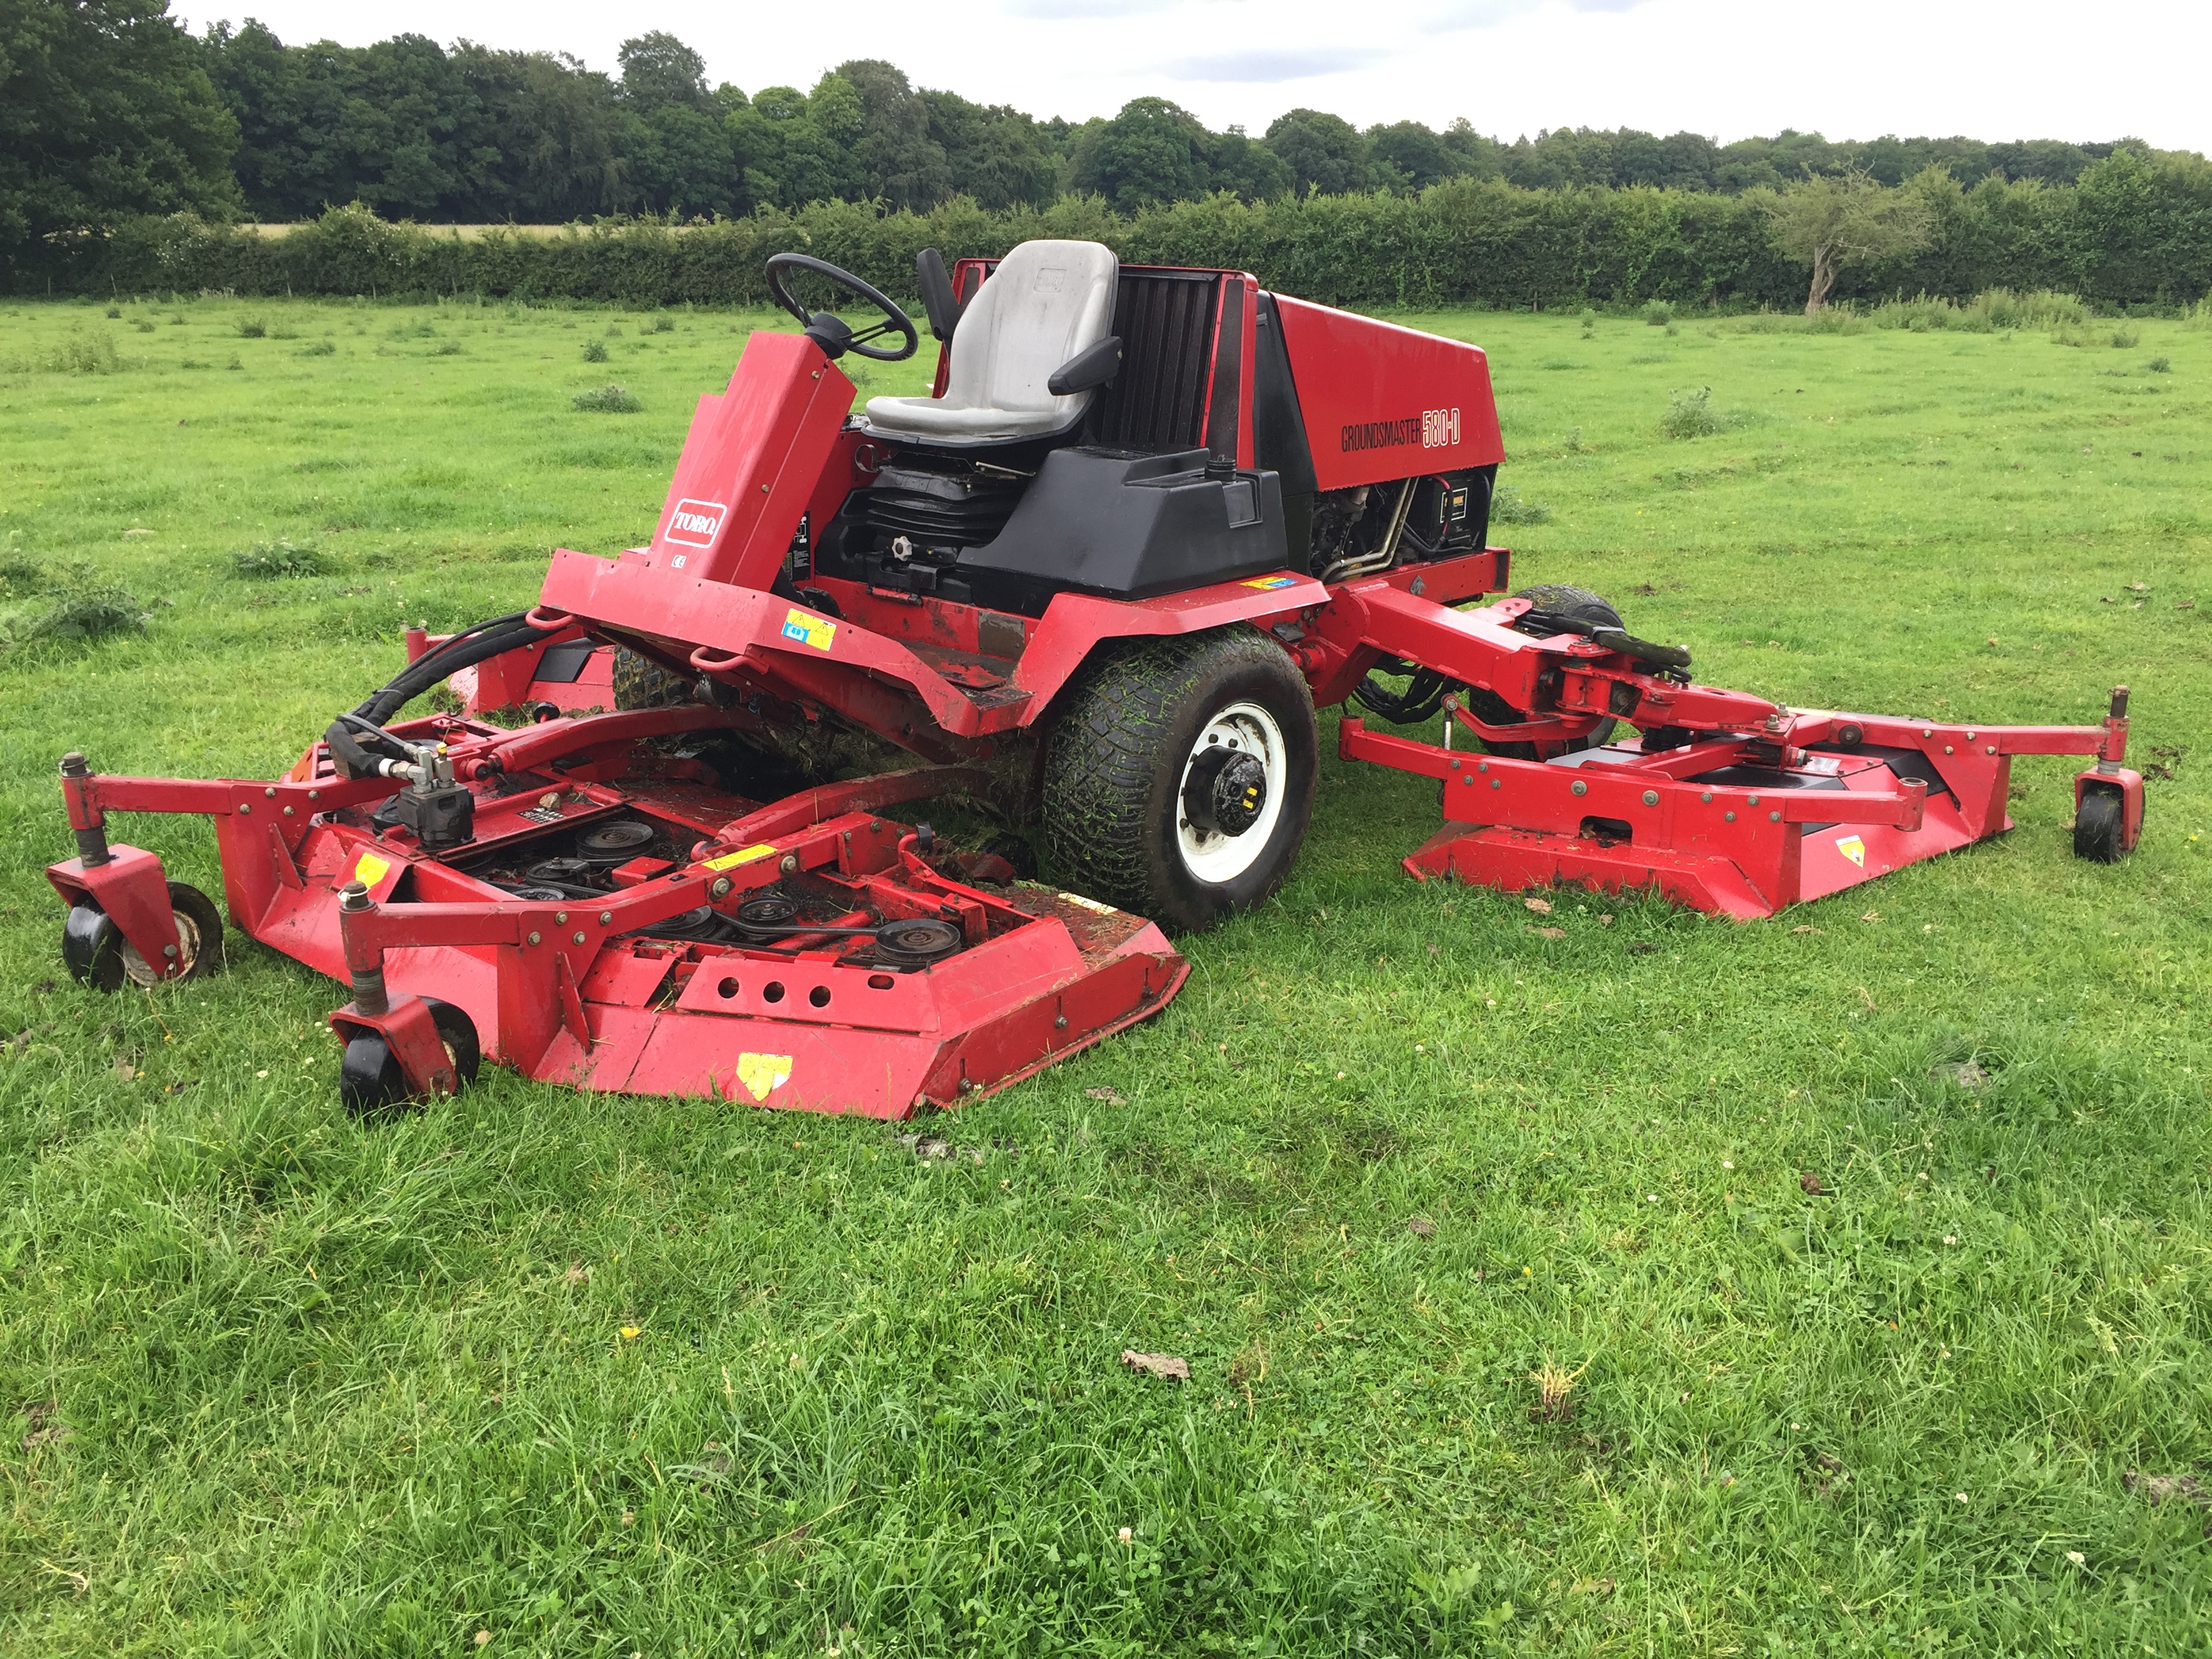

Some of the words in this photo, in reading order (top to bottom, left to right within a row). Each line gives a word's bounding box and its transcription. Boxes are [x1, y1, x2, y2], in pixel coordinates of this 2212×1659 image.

[1341, 418, 1421, 452] GROUNDSMASTER
[1422, 408, 1460, 449] 580-D
[674, 512, 716, 535] TORO
